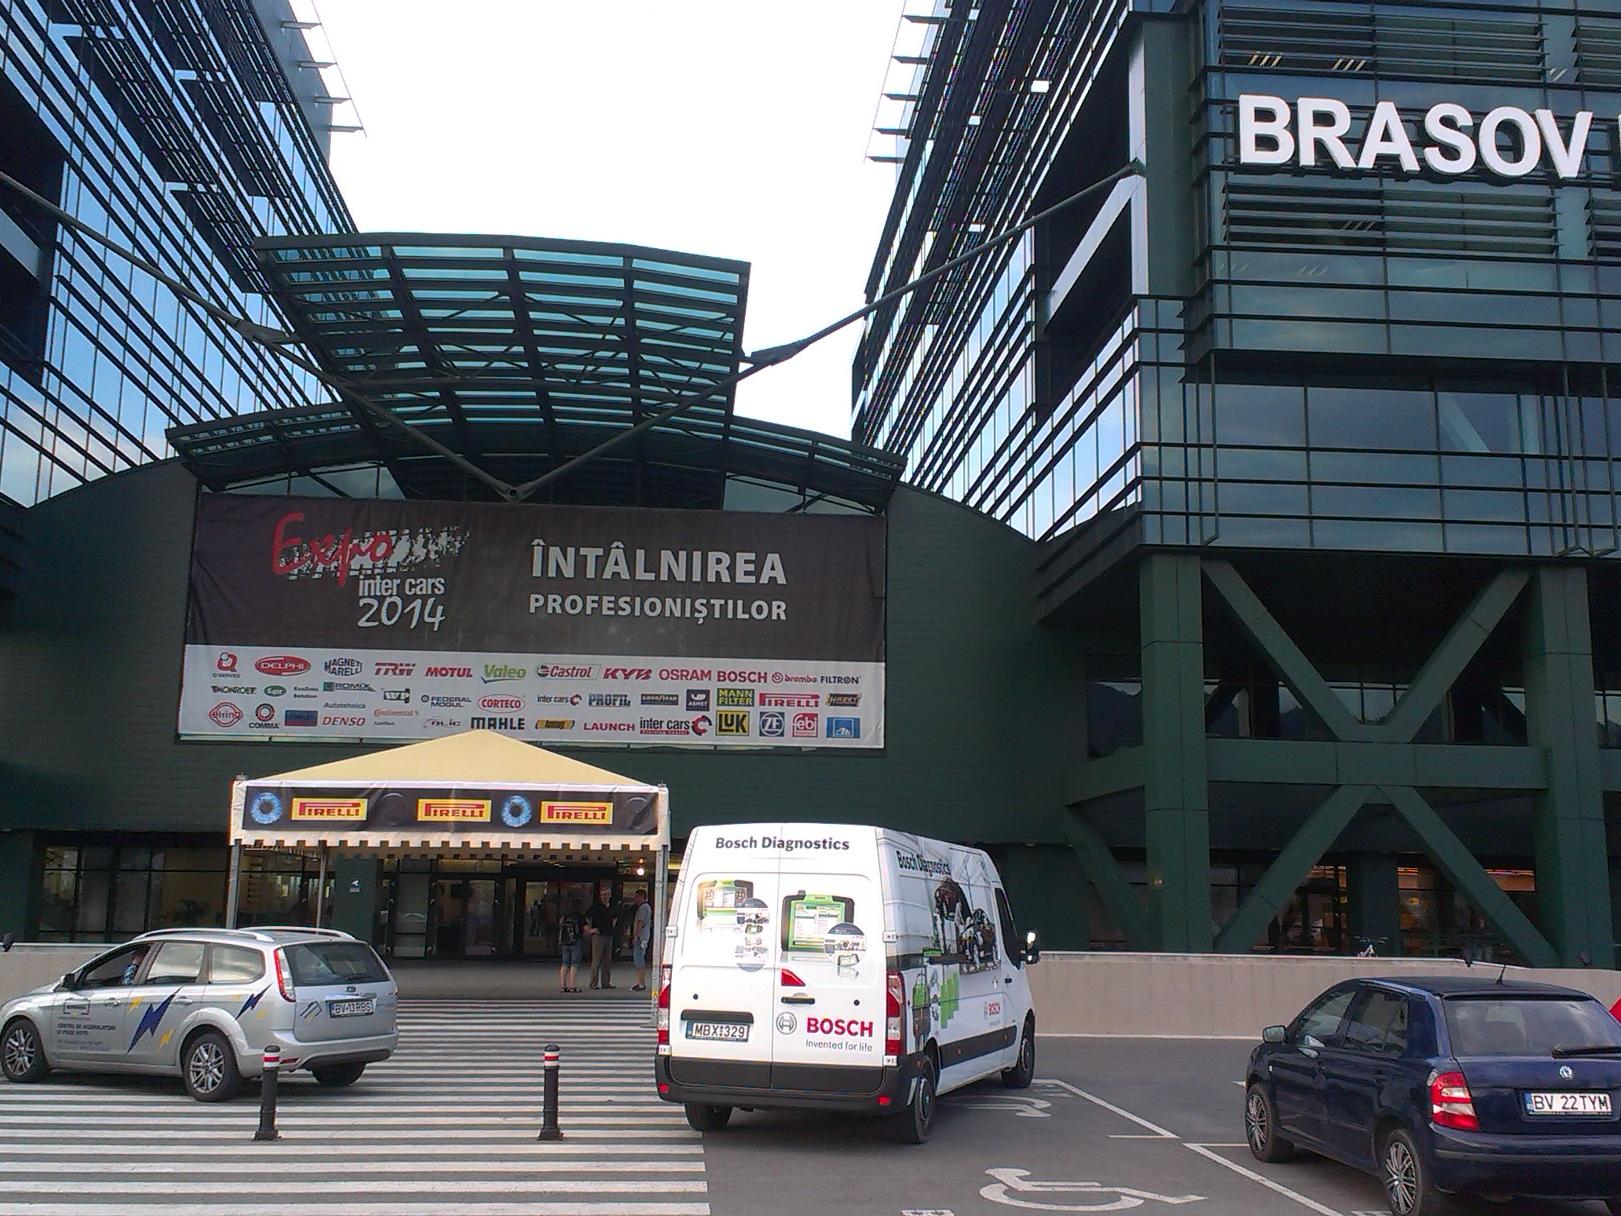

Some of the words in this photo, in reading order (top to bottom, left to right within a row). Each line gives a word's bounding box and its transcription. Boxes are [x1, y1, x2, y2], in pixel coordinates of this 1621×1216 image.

[1239, 93, 1594, 179] BRASOV
[272, 511, 393, 587] Expo
[531, 538, 787, 585] ÎNTÂLNIREA
[358, 575, 400, 597] inter
[404, 576, 446, 595] cars
[357, 596, 446, 631] 2014
[260, 661, 305, 671] DELPHI
[374, 662, 416, 676] TRW
[425, 666, 473, 678] MOTUL
[484, 664, 527, 678] Valeo
[550, 665, 593, 679] Castrol
[603, 667, 653, 680] KYB
[659, 668, 712, 682] OSRAM
[717, 670, 768, 683] BOSCH
[784, 673, 818, 683] brembo
[820, 675, 860, 685] FILTRON
[537, 694, 552, 703] inter
[553, 696, 569, 704] cars
[588, 693, 631, 706] PROFIL
[718, 689, 754, 698] MANN
[759, 692, 820, 708] PIRELLI
[481, 698, 522, 709] CORTECO
[718, 697, 754, 706] FILTER
[322, 716, 367, 726] DENSO
[470, 716, 526, 731] MAHLE
[583, 722, 636, 732] LAUNCH
[639, 716, 666, 730] inter
[666, 719, 690, 730] cars
[763, 715, 780, 730] ZF
[298, 802, 361, 817] PIRELLI
[424, 803, 485, 818] PIRELLI
[548, 805, 607, 819] PIRELLI
[715, 836, 758, 849] Bosch
[761, 836, 850, 852] Diagnostics
[806, 1017, 874, 1037] BOSCH
[805, 1039, 844, 1051] Invented
[845, 1040, 858, 1052] for
[858, 1040, 874, 1053] life
[1533, 1095, 1554, 1110] BV
